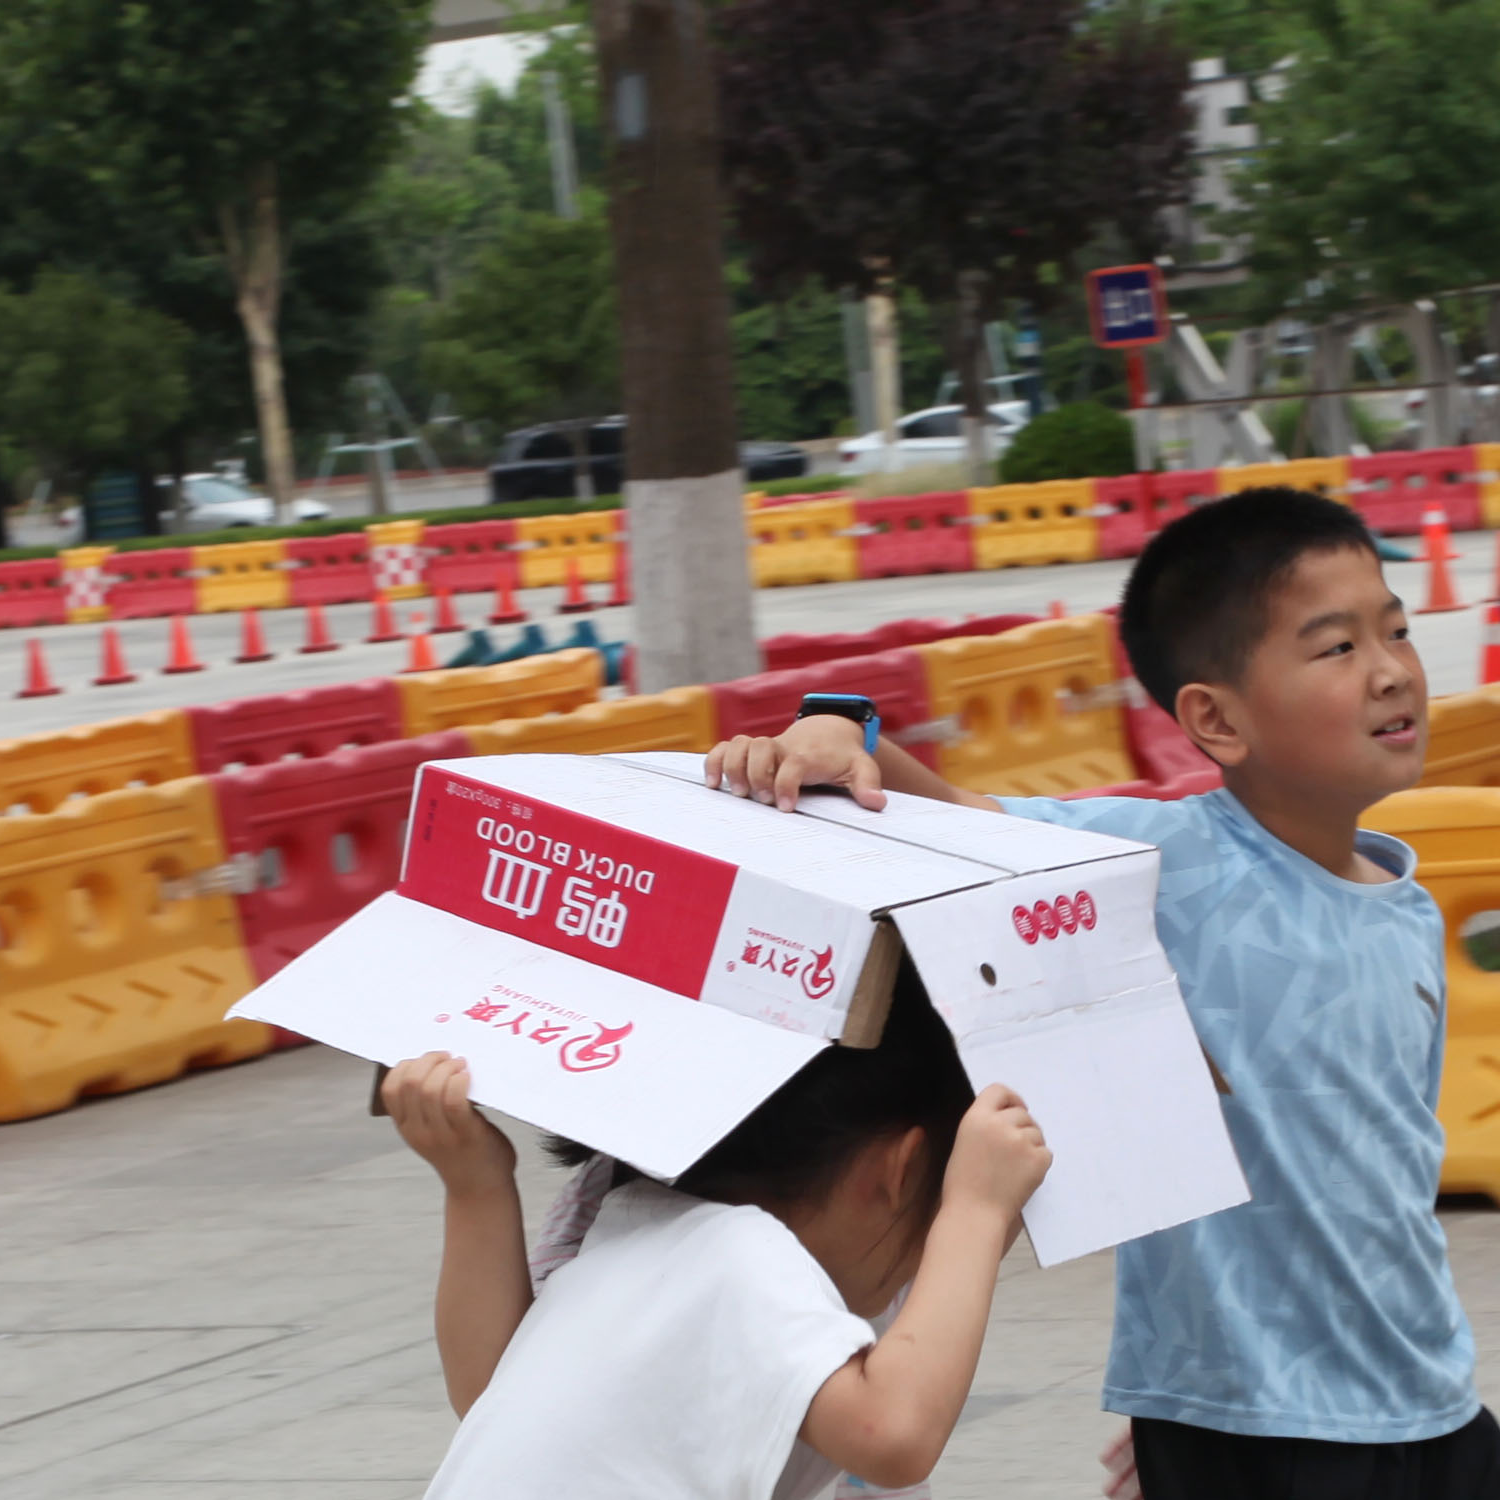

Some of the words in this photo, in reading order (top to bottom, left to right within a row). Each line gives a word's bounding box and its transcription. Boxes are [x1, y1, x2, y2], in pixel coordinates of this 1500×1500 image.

[476, 816, 572, 866] BLOOD
[575, 848, 655, 894] DUCK
[481, 848, 629, 949] 鸭血
[490, 984, 589, 1022] JIUYASHUANG
